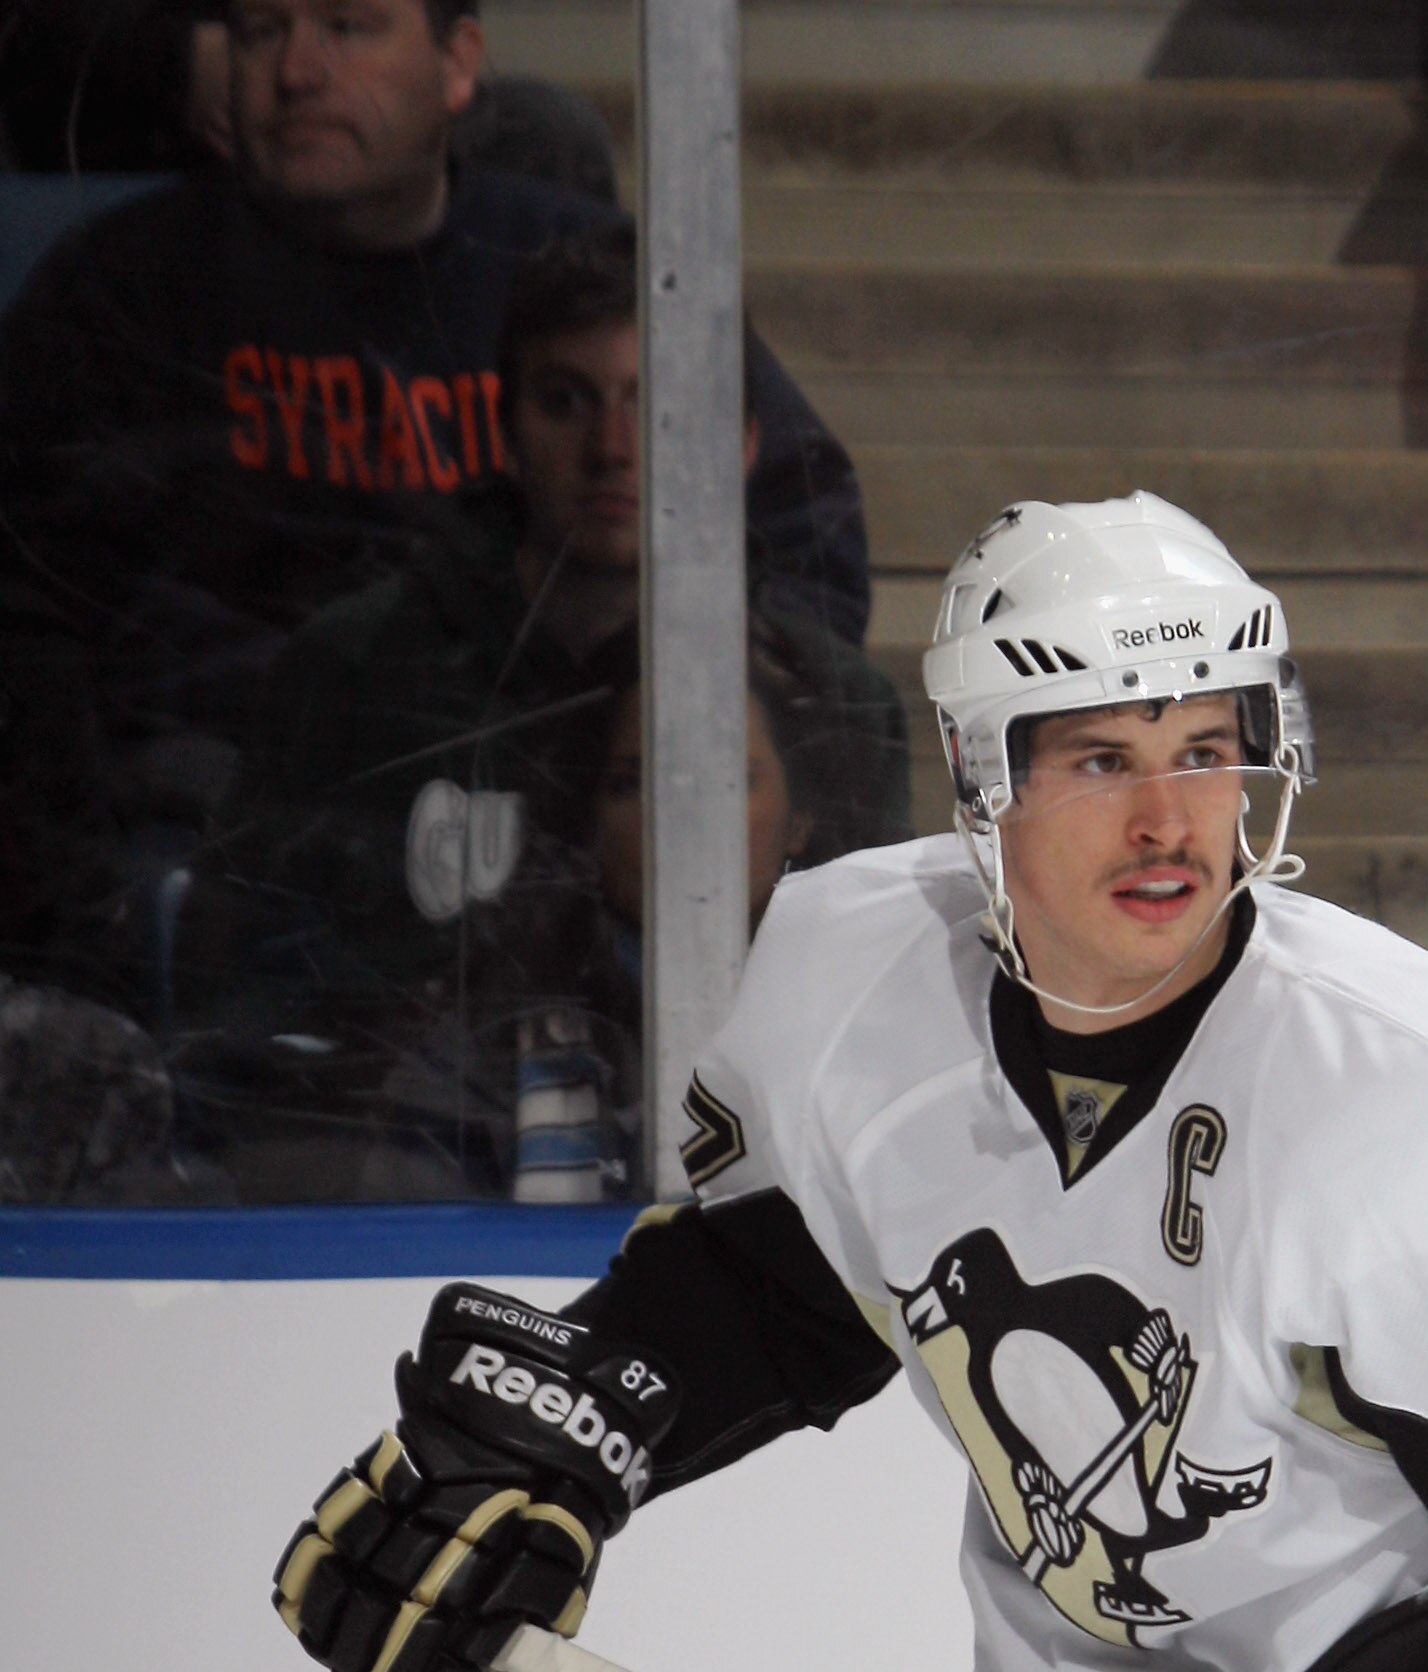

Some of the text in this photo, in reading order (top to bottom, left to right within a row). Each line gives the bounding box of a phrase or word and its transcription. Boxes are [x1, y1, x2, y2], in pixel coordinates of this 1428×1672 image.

[1161, 1103, 1227, 1267] C
[454, 1297, 572, 1346] PENGUINS
[450, 1343, 650, 1509] Reebok
[621, 1360, 667, 1400] 87
